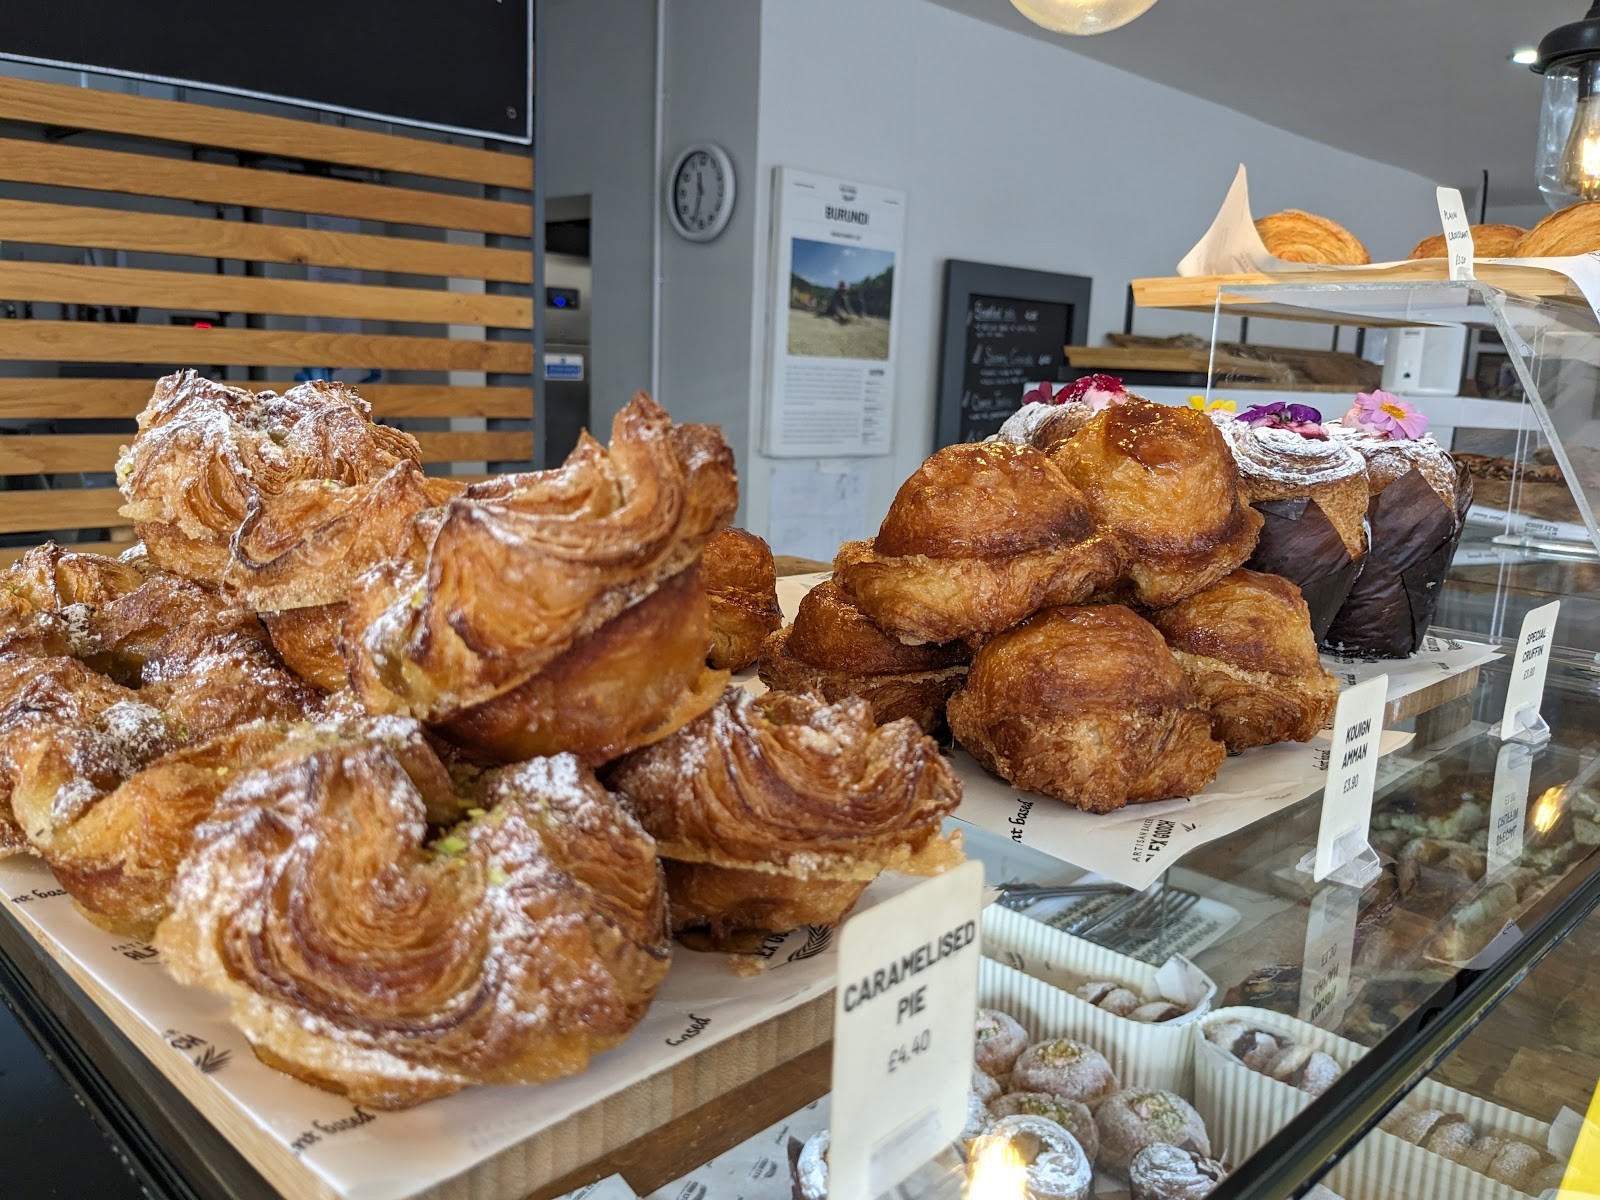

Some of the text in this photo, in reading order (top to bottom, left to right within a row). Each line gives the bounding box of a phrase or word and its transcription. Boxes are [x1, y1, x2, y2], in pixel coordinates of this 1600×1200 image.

[1525, 627, 1547, 645] SPECIAL
[1522, 644, 1545, 663] CRUFFIN
[1345, 718, 1372, 743] KOUIGN
[1341, 743, 1368, 769] AMMAN
[1343, 774, 1360, 794] £3.90
[1008, 798, 1034, 826] based
[1152, 819, 1176, 839] GOOCH
[1131, 831, 1148, 863] ARTISAN
[843, 919, 976, 1013] CARAMELISED
[896, 984, 928, 1025] PIE
[887, 1028, 931, 1073] £4.40
